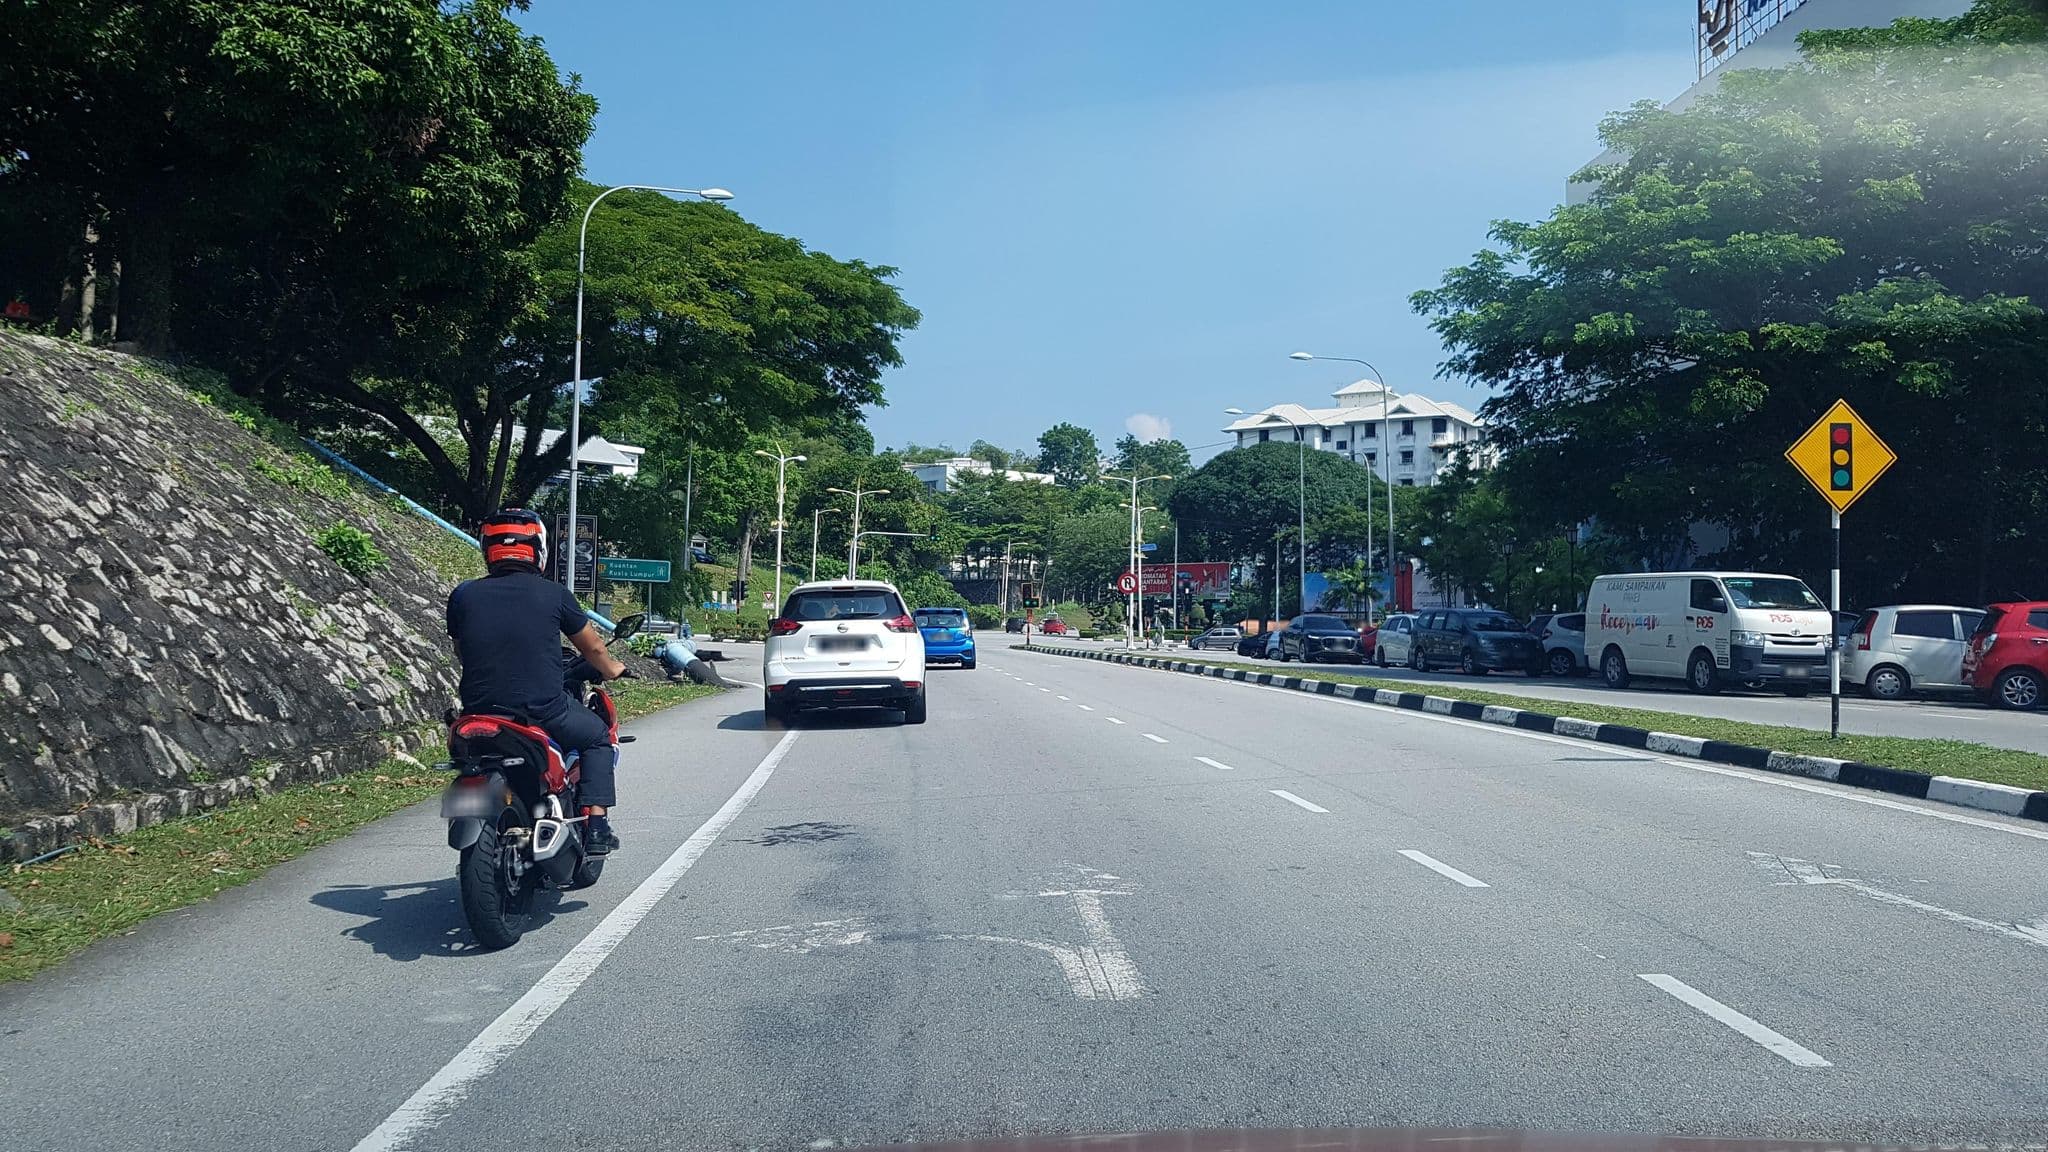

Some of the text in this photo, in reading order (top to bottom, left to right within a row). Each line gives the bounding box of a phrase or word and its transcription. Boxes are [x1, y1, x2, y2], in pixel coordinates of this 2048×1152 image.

[609, 570, 655, 579] Kuala Lumpur
[1607, 581, 1667, 591] KAMI SAMPAIKAN
[1696, 615, 1714, 628] POS
[1769, 613, 1793, 623] POS
